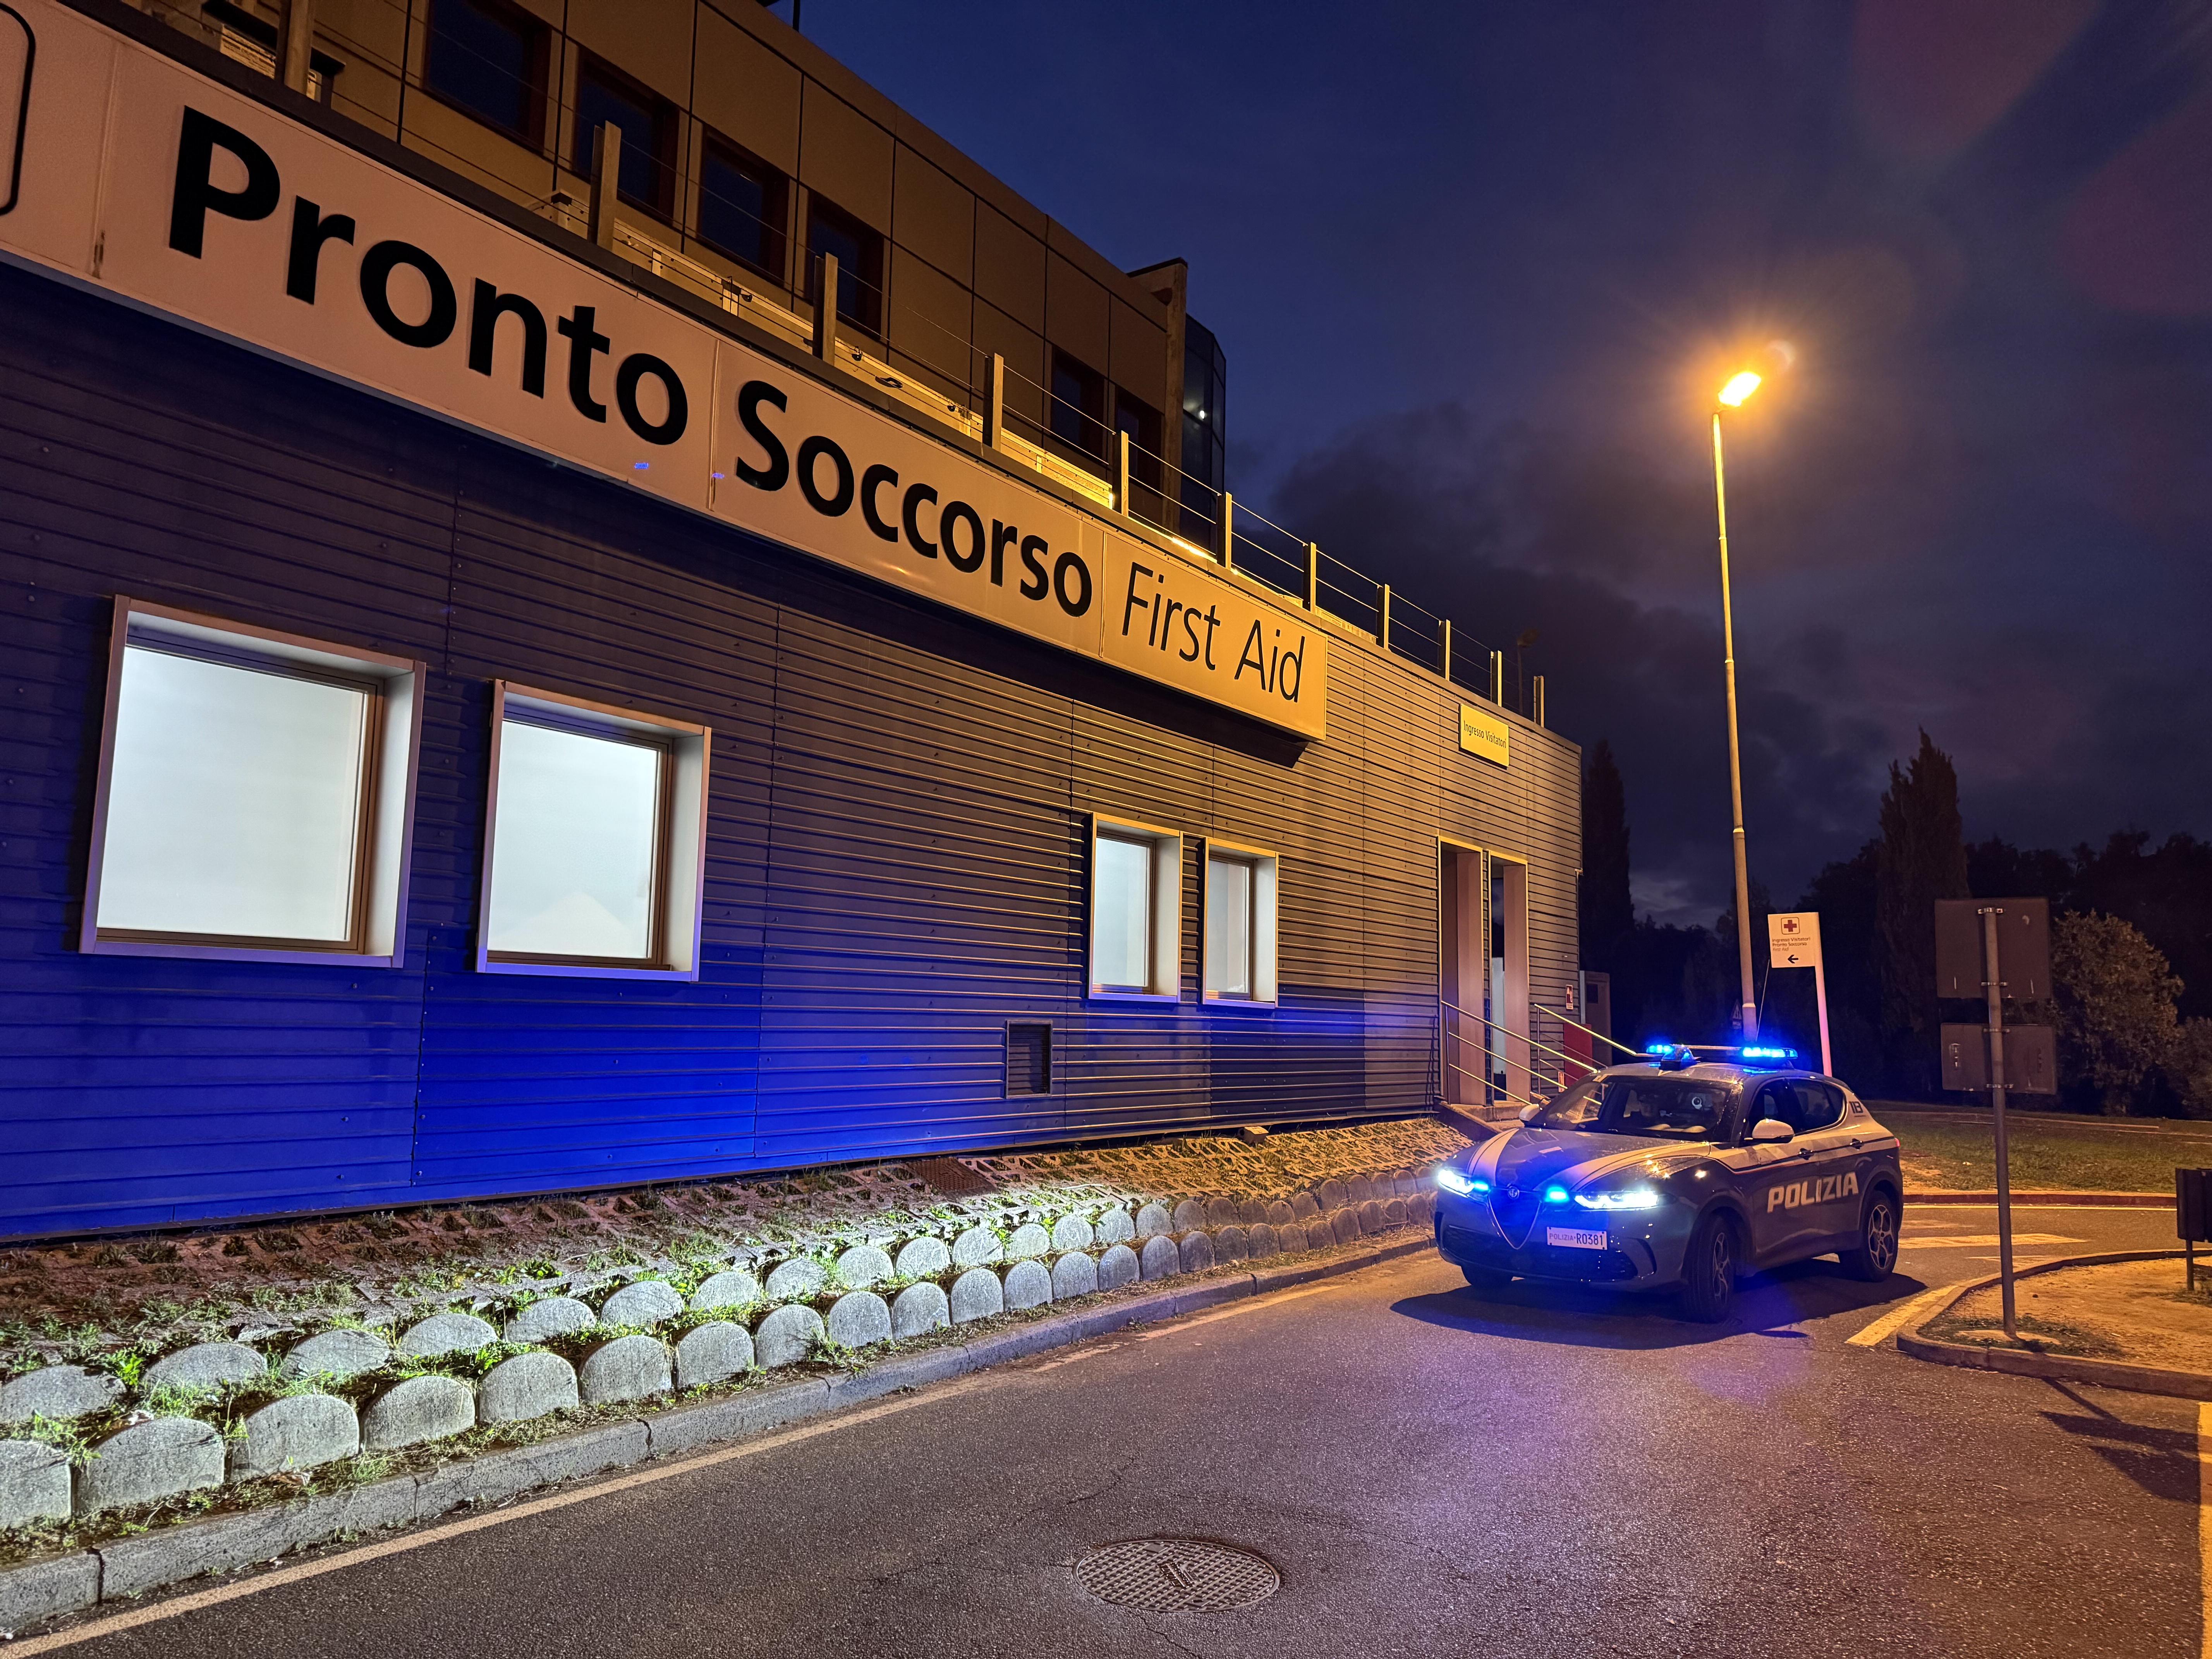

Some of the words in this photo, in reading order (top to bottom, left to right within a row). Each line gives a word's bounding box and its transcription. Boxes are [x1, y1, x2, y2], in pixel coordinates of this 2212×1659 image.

[169, 105, 688, 445] Pronto
[736, 380, 1092, 617] Soccorso
[1122, 562, 1221, 670] First
[1234, 620, 1305, 703] Aid
[1464, 720, 1484, 738] Ingresso
[1486, 730, 1506, 748] Visitatori
[1767, 1171, 1858, 1213] POLIZIA
